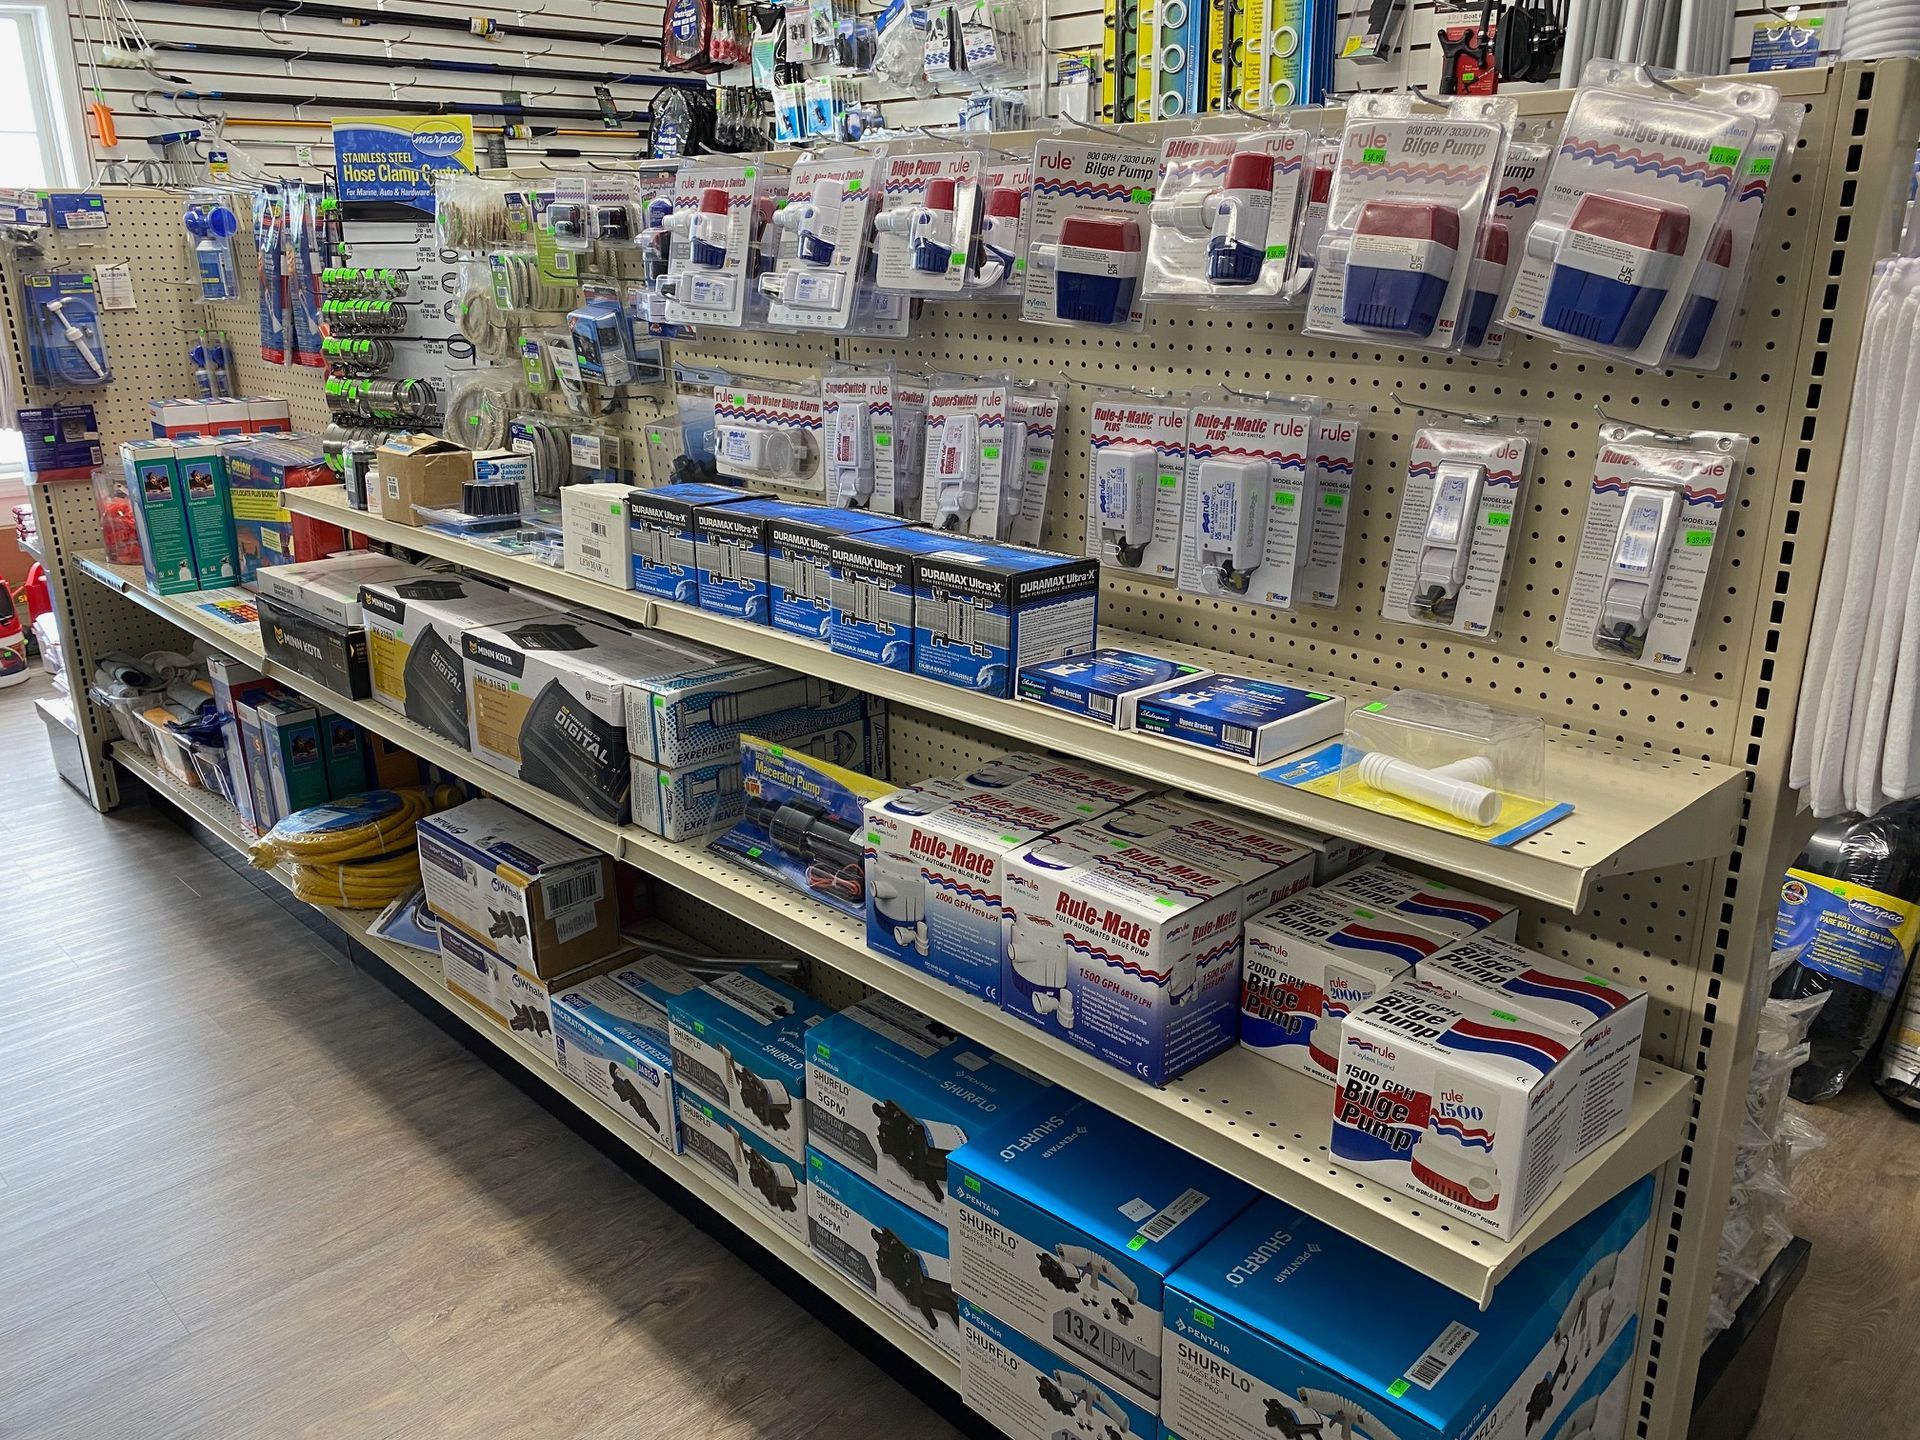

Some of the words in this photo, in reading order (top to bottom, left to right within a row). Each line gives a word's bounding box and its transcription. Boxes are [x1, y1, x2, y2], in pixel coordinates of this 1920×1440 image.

[413, 134, 464, 149] marpac
[1406, 126, 1422, 134] 800
[1450, 128, 1472, 137] 3030
[1266, 136, 1297, 152] rule
[1402, 137, 1443, 157] Bilge
[1443, 139, 1486, 159] Pump
[343, 153, 386, 163] STAINLESS
[388, 153, 413, 163] STEEL
[915, 160, 941, 175] Pump
[1040, 151, 1074, 170] rule
[1087, 152, 1100, 160] 800
[1102, 153, 1116, 161] GPH
[1122, 155, 1140, 164] 3030
[1141, 156, 1156, 165] LPH
[344, 166, 375, 182] Hose
[378, 165, 419, 186] Clamp
[1085, 162, 1115, 177] Bilge
[1118, 164, 1153, 182] Pump
[1503, 165, 1535, 181] ump
[356, 189, 378, 197] Marine,
[1554, 185, 1572, 195] 1000
[1621, 265, 1635, 277] UK
[1026, 299, 1047, 308] xylem
[1312, 304, 1337, 314] xylem
[1518, 309, 1535, 320] Year
[826, 383, 867, 395] SuperSwitch
[762, 396, 781, 408] Water
[932, 394, 978, 408] SuperSwitch
[1095, 408, 1154, 425] Rule-A-Matic
[1158, 411, 1185, 428] rule
[1104, 422, 1121, 432] PLUS
[1195, 413, 1267, 432] Rule-A-Matic
[1273, 418, 1306, 438] rule
[1205, 429, 1227, 441] PLUS
[1321, 424, 1355, 442] rule
[699, 517, 733, 531] DURAMAX
[1682, 517, 1704, 525] MODEL
[774, 530, 809, 546] DURAMAX
[811, 539, 830, 550] Ultra-
[579, 558, 603, 572] LEWMAR
[832, 549, 873, 567] DURAMAX
[874, 560, 903, 574] Ultra-X
[921, 567, 968, 586] DURAMAX
[969, 578, 1001, 593] Ultra-X
[1020, 576, 1066, 594] DURAMAX
[1067, 570, 1095, 584] Ultra-X
[283, 632, 303, 650] MINN
[303, 640, 322, 660] KOTA
[478, 646, 495, 660] MINN
[496, 654, 513, 666] KOTA
[430, 653, 462, 693] DIGITAL
[760, 726, 796, 741] BENNETT
[802, 711, 857, 728] ADVANTAGE
[1141, 709, 1170, 722] Shakespeare
[1179, 717, 1194, 728] Upper
[1194, 721, 1214, 732] Bracket
[555, 710, 609, 765] DIGITAL
[755, 759, 796, 787] Macerator
[797, 776, 821, 795] Pump
[884, 819, 897, 831] rule
[909, 828, 995, 877] Rule-Mate
[909, 850, 925, 862] FULLY
[925, 856, 957, 876] AUTOMATED
[957, 866, 973, 880] BILGE
[974, 873, 991, 886] PUMP
[1117, 847, 1222, 887] Rule-Mate
[500, 882, 523, 903] Whale
[1024, 879, 1038, 892] rule
[1336, 881, 1397, 906] Pump
[1348, 875, 1405, 897] Bilge
[935, 890, 954, 907] 2000
[954, 897, 972, 913] GPH
[971, 907, 985, 918] 7570
[985, 909, 999, 923] LPH
[1278, 903, 1338, 928] Bilge
[1849, 901, 1904, 923] marpac
[1056, 891, 1150, 948] Rule-Mate
[1191, 909, 1238, 941] Rule-Mate
[1265, 911, 1329, 938] Pump
[1837, 920, 1870, 937] BATTAGE
[1055, 914, 1072, 927] FULLY
[1073, 921, 1110, 943] AUTOMATED
[1111, 937, 1129, 951] BILGE
[1130, 944, 1150, 958] PUMP
[1268, 943, 1288, 958] rule
[1450, 946, 1516, 975] Bilge
[1498, 954, 1532, 968] GPH
[728, 974, 746, 988] 3.5
[1247, 959, 1276, 982] 2000
[1277, 971, 1305, 991] GPH
[1436, 953, 1507, 986] Pump
[520, 979, 545, 1000] Whale
[1079, 967, 1100, 986] 1500
[1101, 976, 1120, 993] GPH
[1120, 988, 1138, 1002] 6819
[1138, 993, 1152, 1009] LPH
[1248, 973, 1298, 1010] Bilge
[1330, 976, 1347, 990] rule
[1332, 986, 1362, 1002] 2000
[1428, 986, 1452, 999] rule
[1374, 995, 1447, 1025] Bilge
[1388, 988, 1423, 1005] 1500
[1425, 1002, 1463, 1017] GPH
[552, 1005, 587, 1034] MACERATOR
[1245, 997, 1302, 1036] Pump
[1362, 1005, 1441, 1040] Pump
[673, 1027, 702, 1050] SHURFLO
[635, 1037, 672, 1067] MACERATOR
[762, 1043, 803, 1071] SHURFLO
[1373, 1046, 1396, 1061] rule
[639, 1064, 658, 1085] JABSCO
[814, 1070, 849, 1096] SHURFLO
[1345, 1064, 1380, 1087] 1500
[1382, 1078, 1415, 1101] GPH
[818, 1091, 846, 1118] 5GPM
[940, 1080, 998, 1114] SHURFLO
[1342, 1078, 1409, 1123] Bilge
[1441, 1089, 1462, 1103] rule
[683, 1103, 711, 1128] SHURFLO
[1440, 1103, 1483, 1121] 1500
[1340, 1101, 1413, 1152] Pump
[999, 1115, 1065, 1162] SHURFLO
[816, 1190, 850, 1219] SHURFLO
[966, 1193, 1000, 1217] PENTAIR
[818, 1212, 842, 1234] 4GPM
[959, 1208, 1017, 1250] SHURFLO
[1225, 1230, 1292, 1288] SHURFLO
[1274, 1249, 1311, 1284] PENTAIR
[971, 1314, 1002, 1339] PENTAIR
[966, 1326, 1019, 1372] SHURFLO
[1064, 1309, 1100, 1348] 13.2
[1102, 1334, 1137, 1372] LPM
[1188, 1326, 1230, 1355] PENTAIR
[1177, 1357, 1210, 1381] TROUSSE
[1211, 1377, 1221, 1387] DE
[1177, 1366, 1203, 1387] LAVAGE
[1178, 1342, 1251, 1393] SHURFLO
